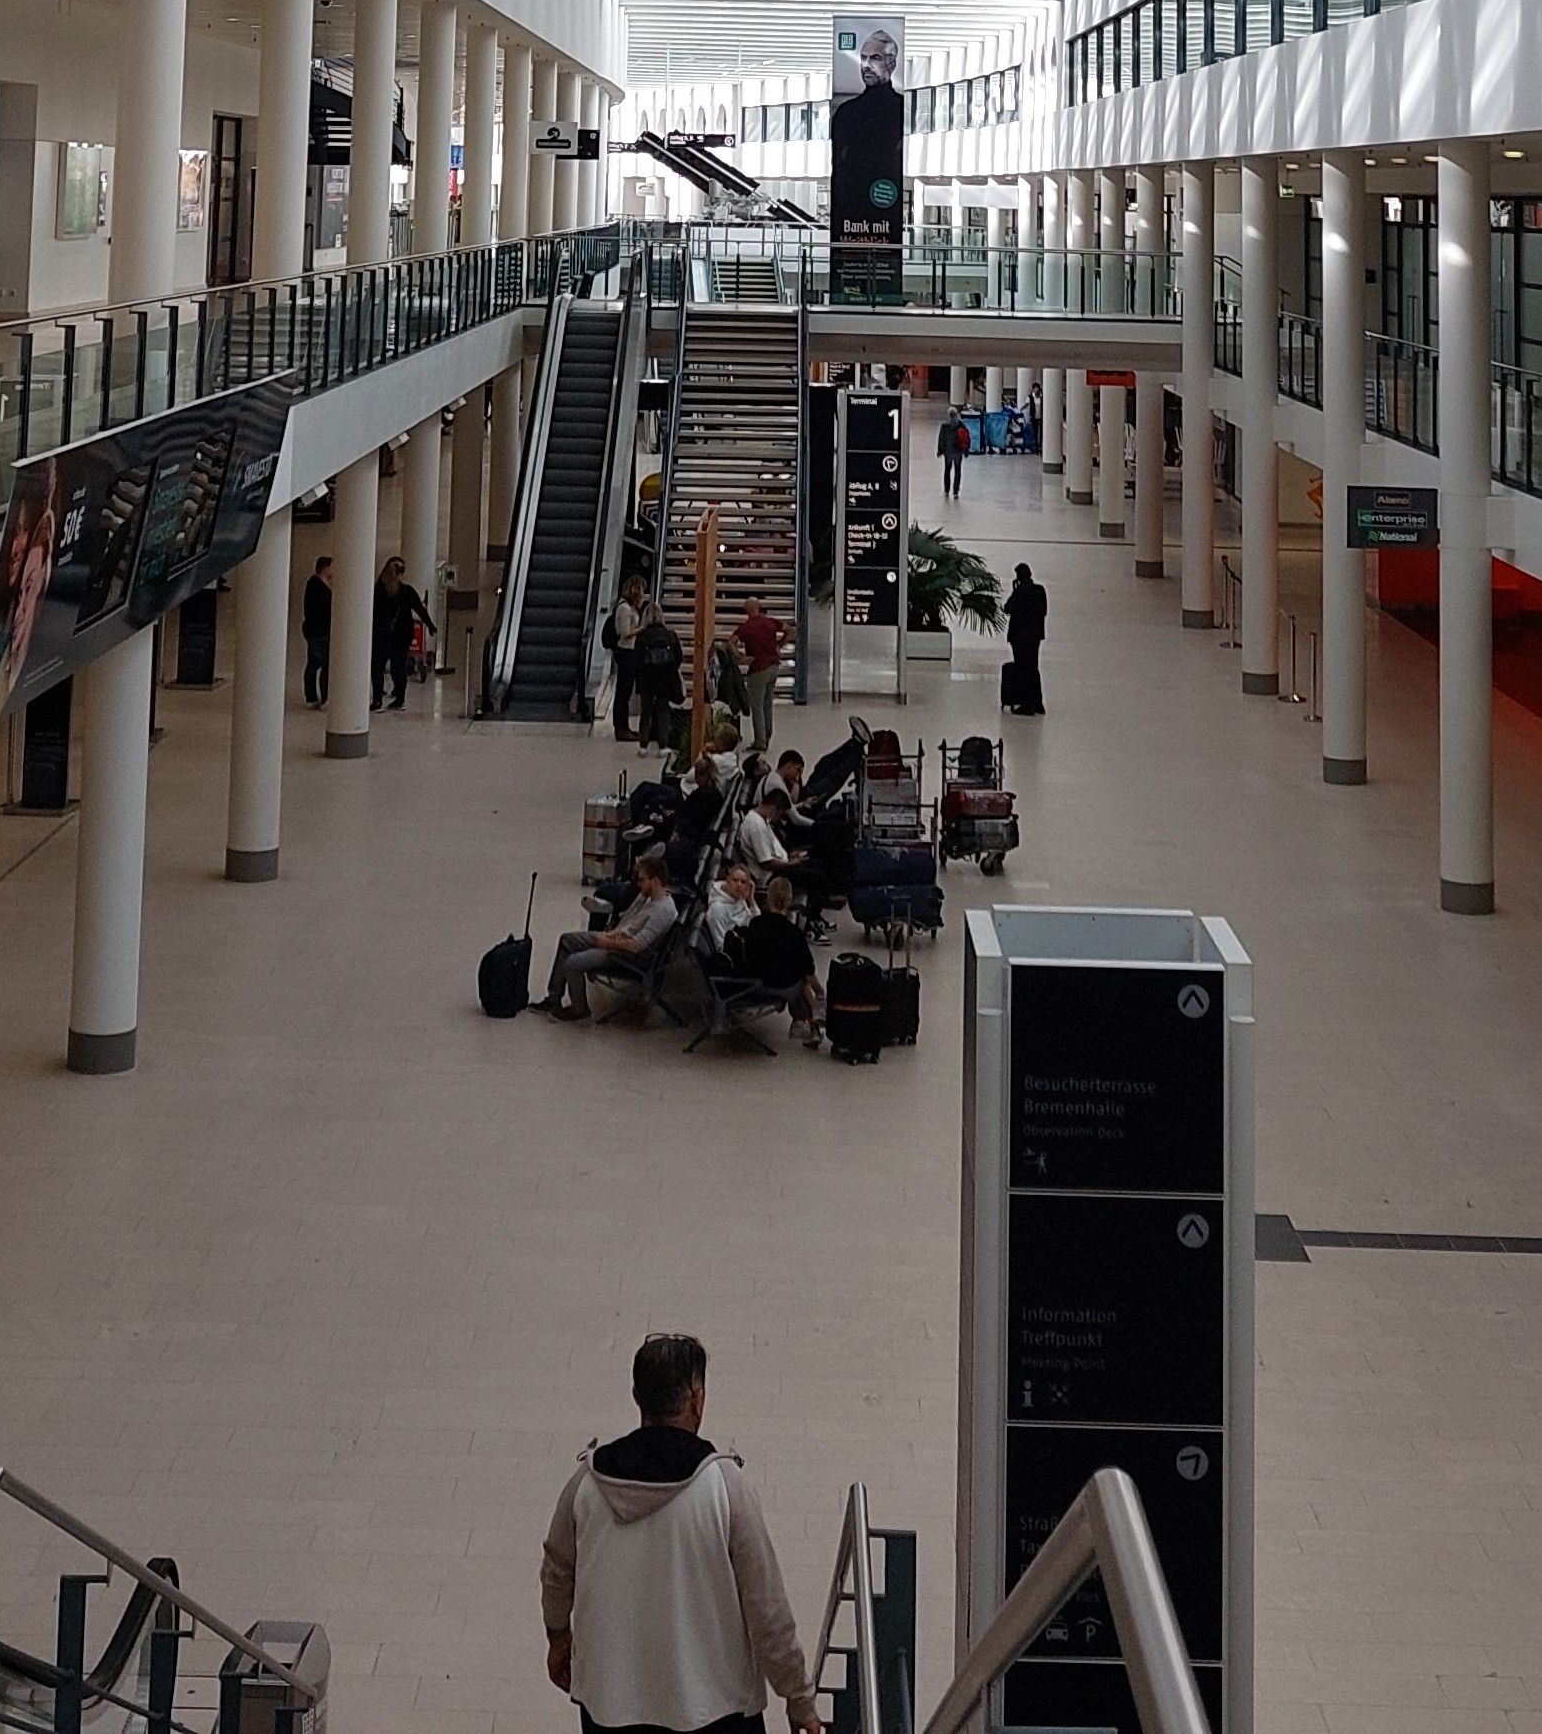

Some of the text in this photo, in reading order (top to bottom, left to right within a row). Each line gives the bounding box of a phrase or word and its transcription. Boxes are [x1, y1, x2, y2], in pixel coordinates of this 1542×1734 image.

[843, 219, 891, 234] Bank mit
[849, 396, 878, 406] Terminal
[887, 408, 899, 440] 1
[1376, 494, 1410, 505] Alamo
[1360, 513, 1427, 525] enterprise
[1378, 530, 1419, 542] National
[1024, 1074, 1157, 1095] Besucherterrasse
[1024, 1098, 1125, 1115] Bremenhalle
[1022, 1306, 1117, 1323] Information
[1022, 1329, 1103, 1348] Treffpunkt
[1022, 1355, 1105, 1371] Meeting Point
